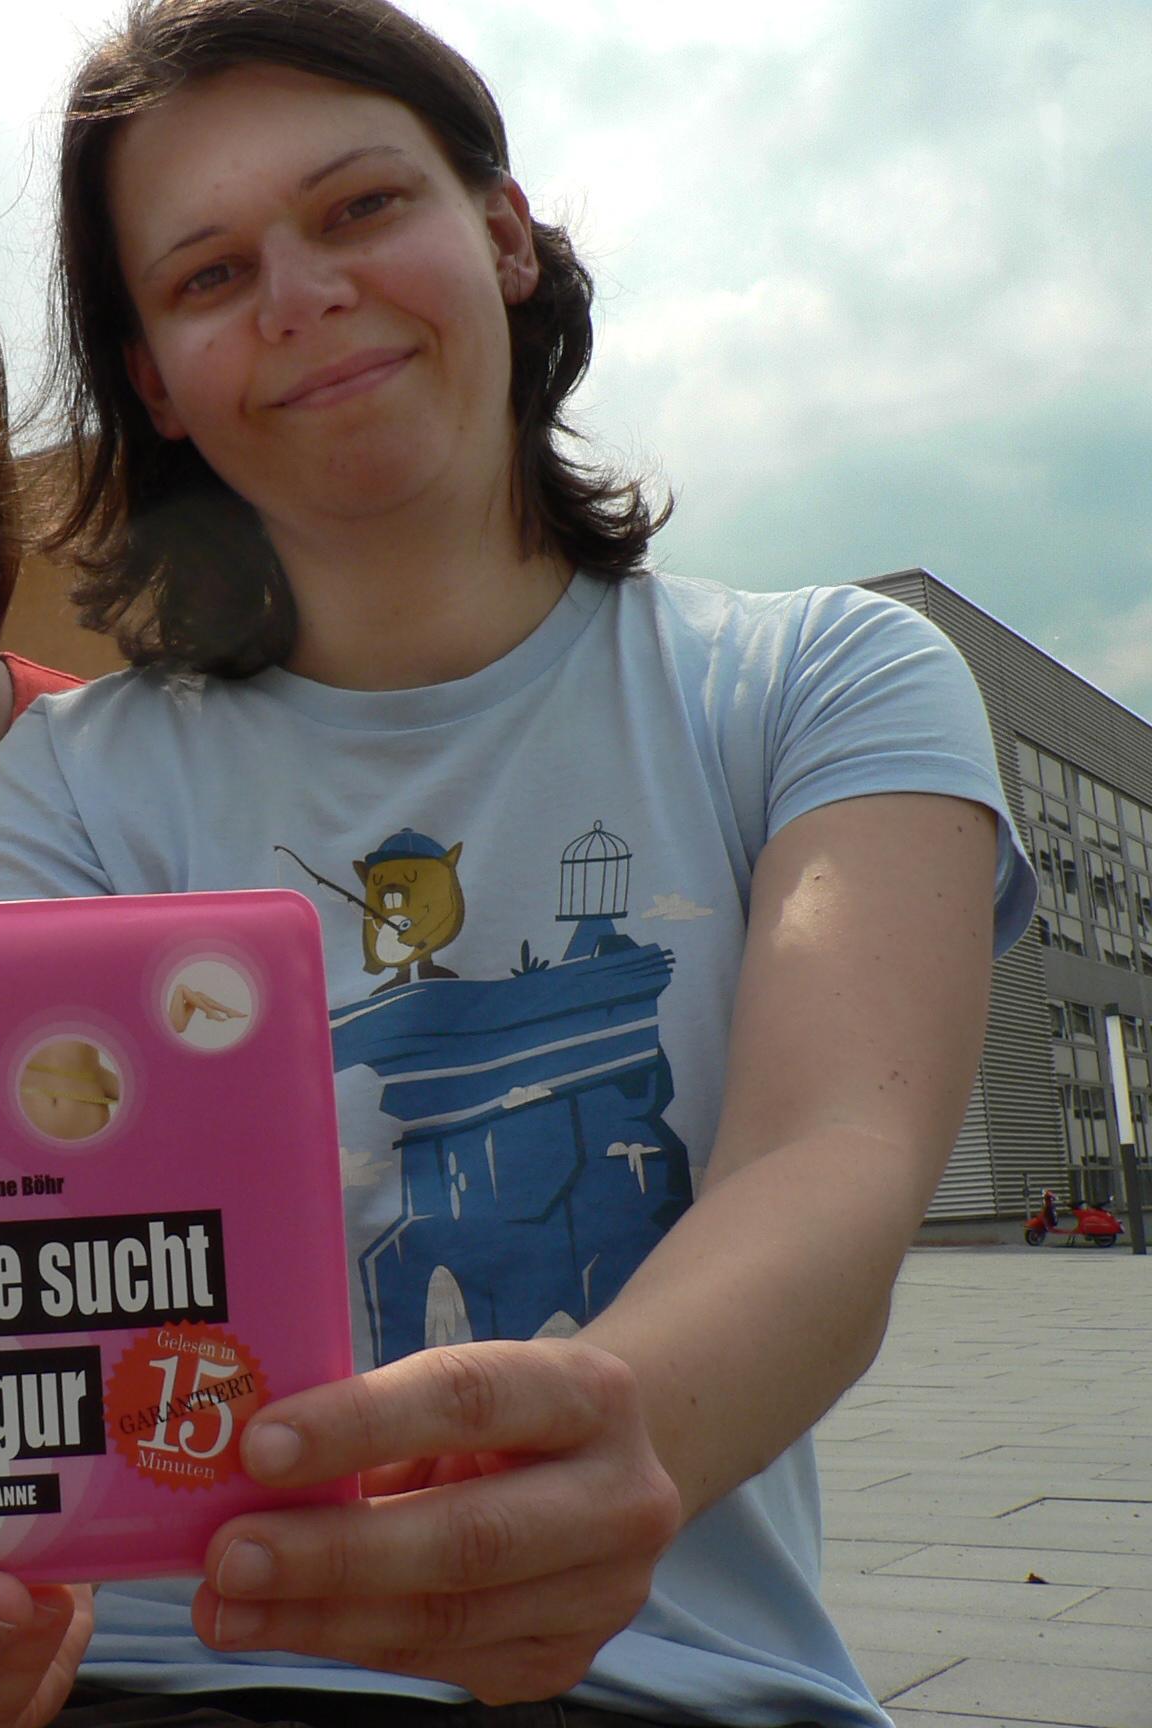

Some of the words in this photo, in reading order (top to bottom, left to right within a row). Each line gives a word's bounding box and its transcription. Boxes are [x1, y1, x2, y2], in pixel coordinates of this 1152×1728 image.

[21, 1175, 65, 1196] Böhr
[38, 1220, 215, 1317] sucht
[157, 1329, 216, 1358] Gelesen
[221, 1342, 236, 1361] in
[120, 1373, 254, 1435] GARANTIERT
[137, 1355, 239, 1459] 15
[137, 1450, 215, 1480] Minuten
